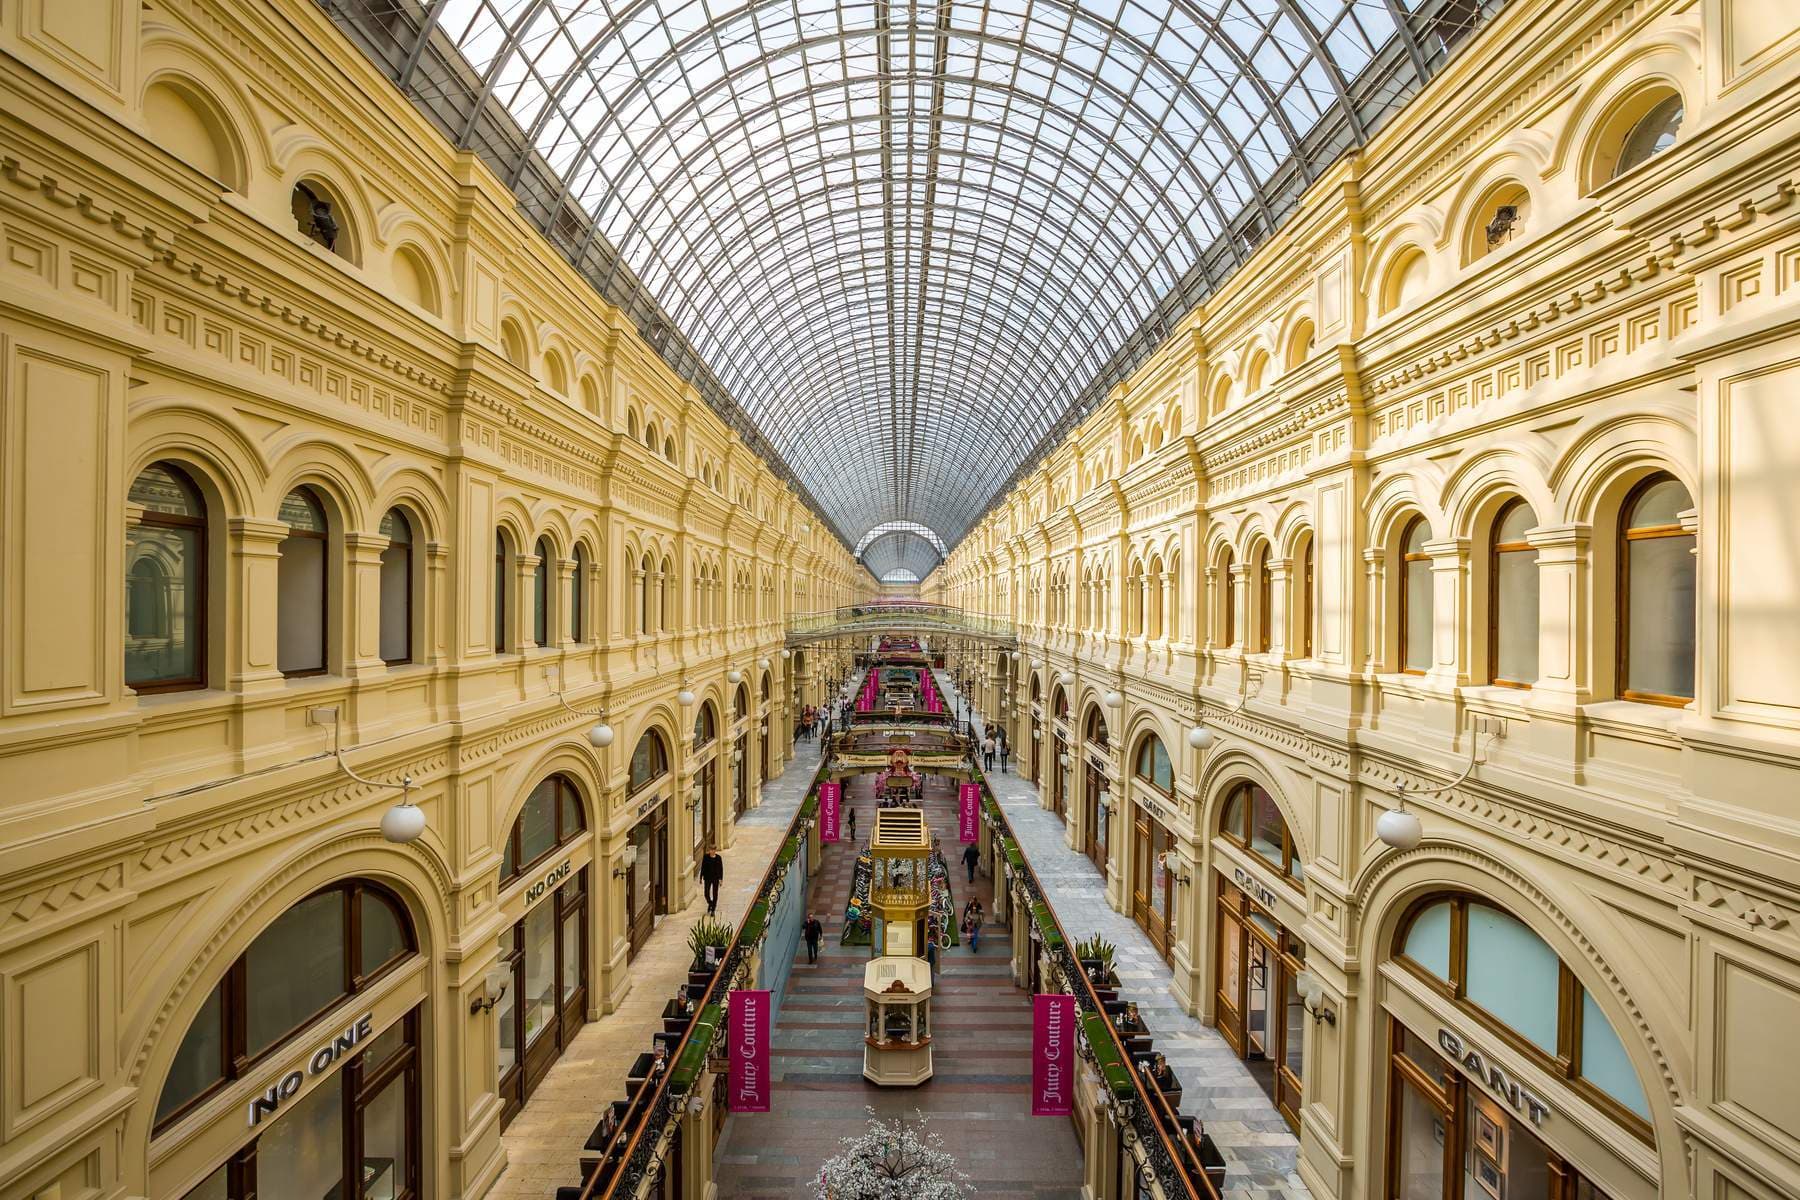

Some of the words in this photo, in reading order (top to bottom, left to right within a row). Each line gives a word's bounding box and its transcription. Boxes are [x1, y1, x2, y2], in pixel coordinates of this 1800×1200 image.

[826, 786, 834, 816] Couture
[965, 786, 974, 817] Couture
[1142, 795, 1165, 819] GANT
[825, 816, 835, 838] Juicy
[964, 817, 974, 837] Juicy
[524, 880, 545, 906] NO
[545, 859, 571, 887] ONE
[1234, 867, 1277, 910] GANT
[740, 998, 757, 1059] Couture
[1044, 1001, 1061, 1060] Couture
[248, 1070, 304, 1127] NO
[307, 1011, 373, 1075] ONE
[740, 1062, 759, 1102] Juicy
[1043, 1063, 1063, 1103] Juicy
[1438, 1028, 1550, 1125] GANT
